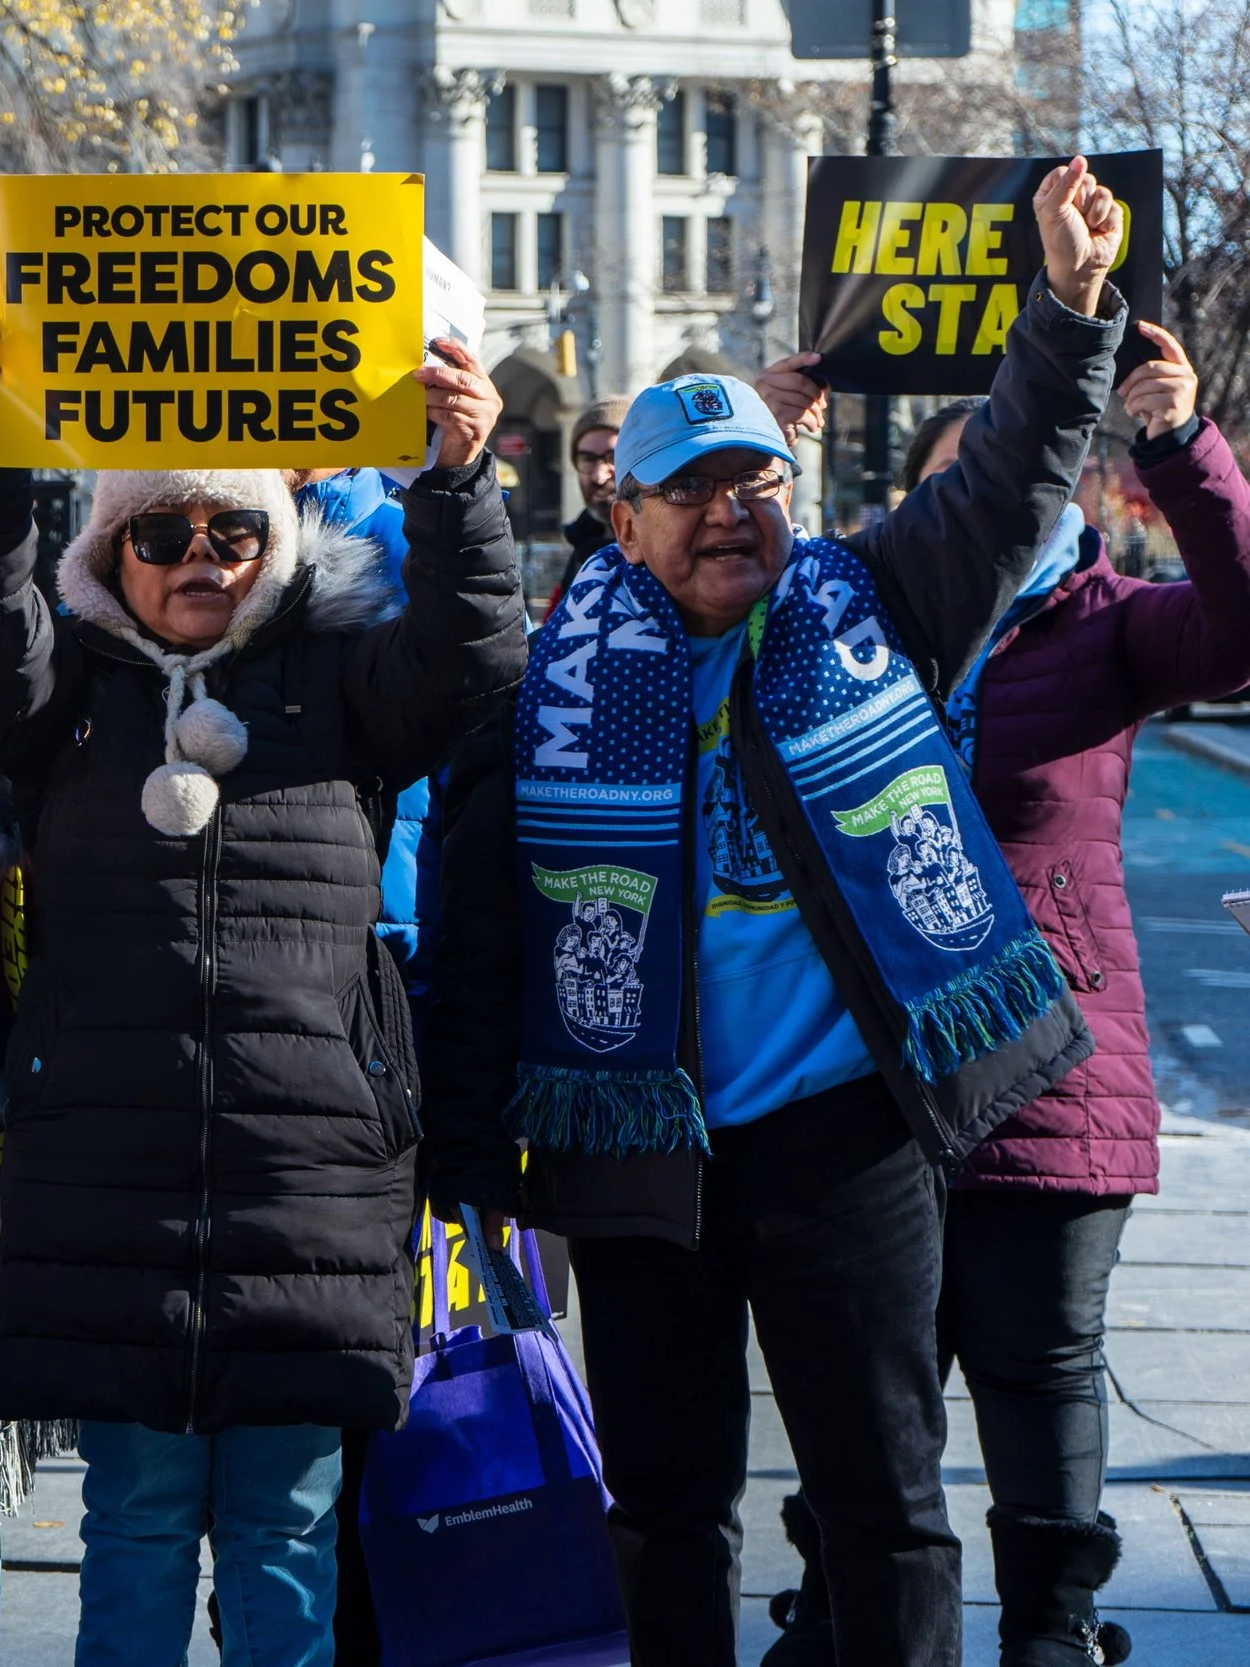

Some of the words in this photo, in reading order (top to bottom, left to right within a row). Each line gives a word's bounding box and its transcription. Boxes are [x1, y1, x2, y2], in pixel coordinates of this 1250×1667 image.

[55, 205, 248, 237] PROTECT
[255, 204, 348, 237] OUR
[831, 201, 1014, 276] HERE
[6, 250, 396, 304] FREEDOMS
[43, 319, 361, 373] FAMILIES
[878, 283, 1020, 356] STA
[45, 389, 359, 442] FUTURES
[788, 680, 915, 756] MAKETHEROADNY.ORG
[521, 785, 673, 801] MAKETHEROADNY.ORG
[851, 800, 889, 827] MAKE
[886, 780, 910, 803] THE
[910, 773, 942, 787] ROAD
[898, 790, 920, 809] NEW
[920, 786, 944, 797] YORK
[544, 876, 578, 889] MAKE
[580, 872, 607, 885] THE
[610, 872, 651, 893] ROAD
[589, 886, 615, 896] NEW
[618, 889, 647, 905] YORK
[445, 1498, 533, 1526] EmblemHealth
